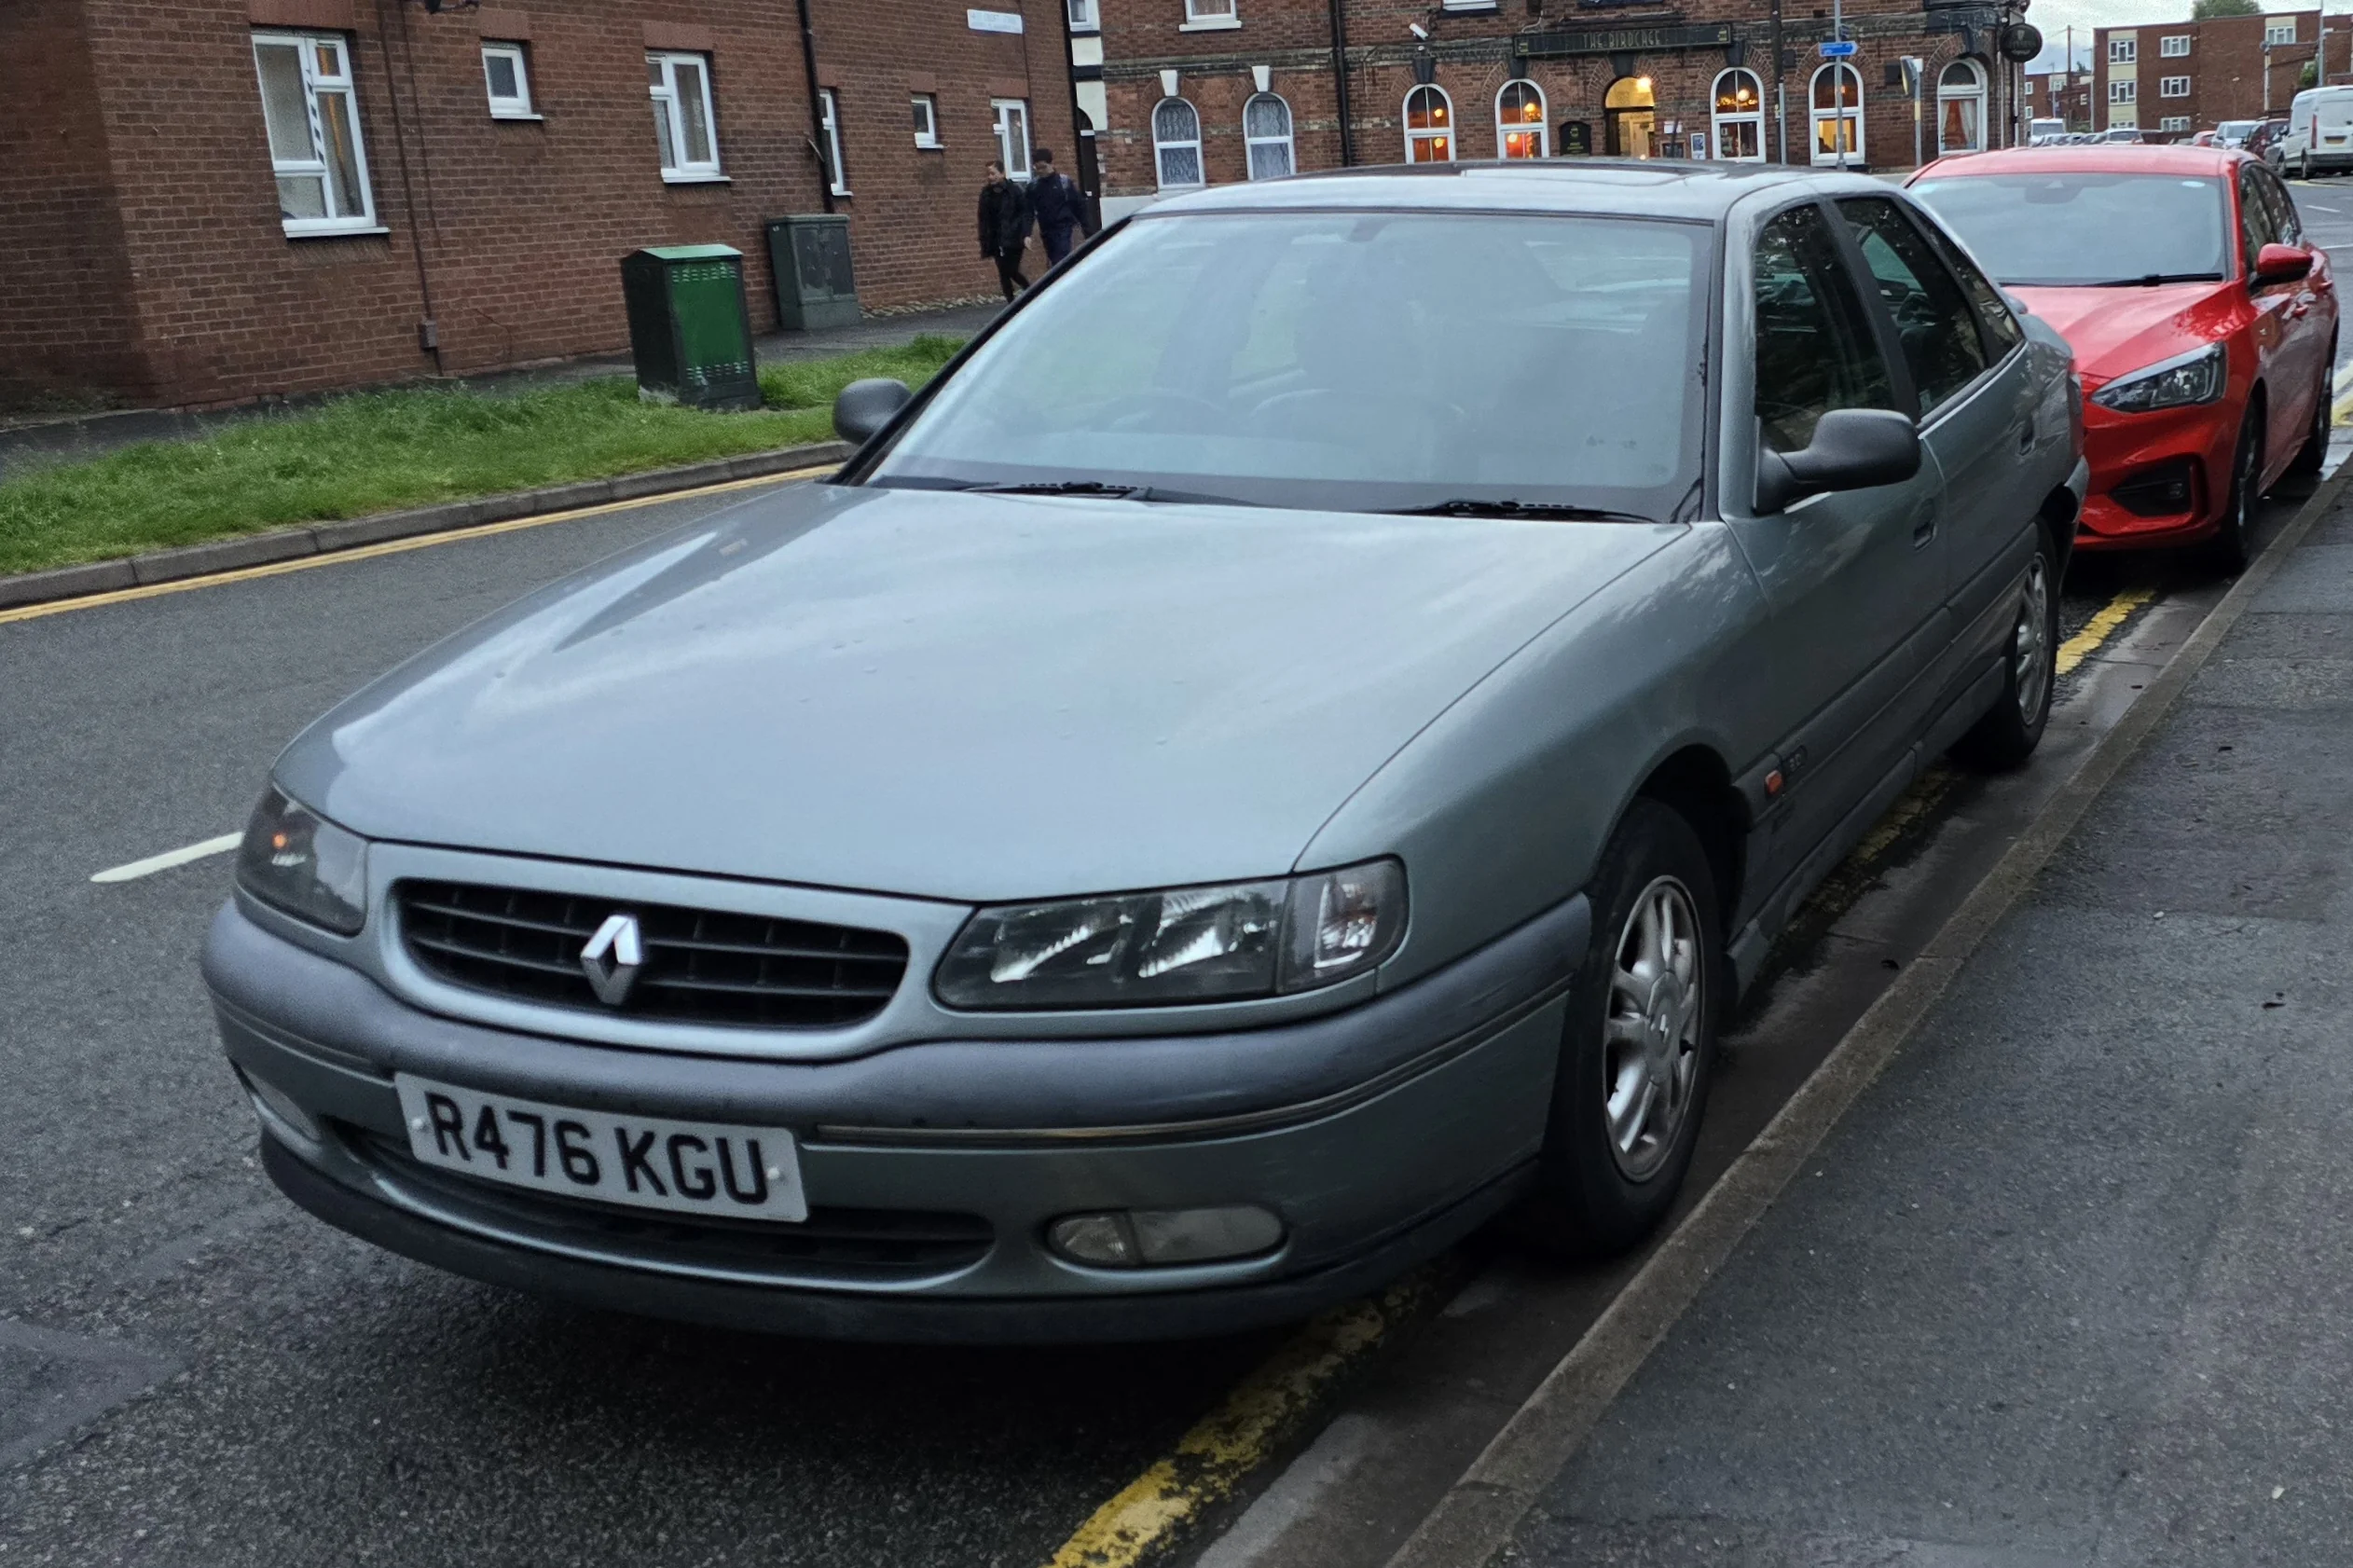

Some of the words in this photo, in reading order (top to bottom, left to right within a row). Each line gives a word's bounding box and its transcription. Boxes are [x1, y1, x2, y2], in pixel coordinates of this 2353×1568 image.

[1583, 32, 1603, 48] THE
[1608, 29, 1660, 48] BIRDCAGE
[424, 1092, 600, 1187] R476
[614, 1126, 770, 1204] KGU
